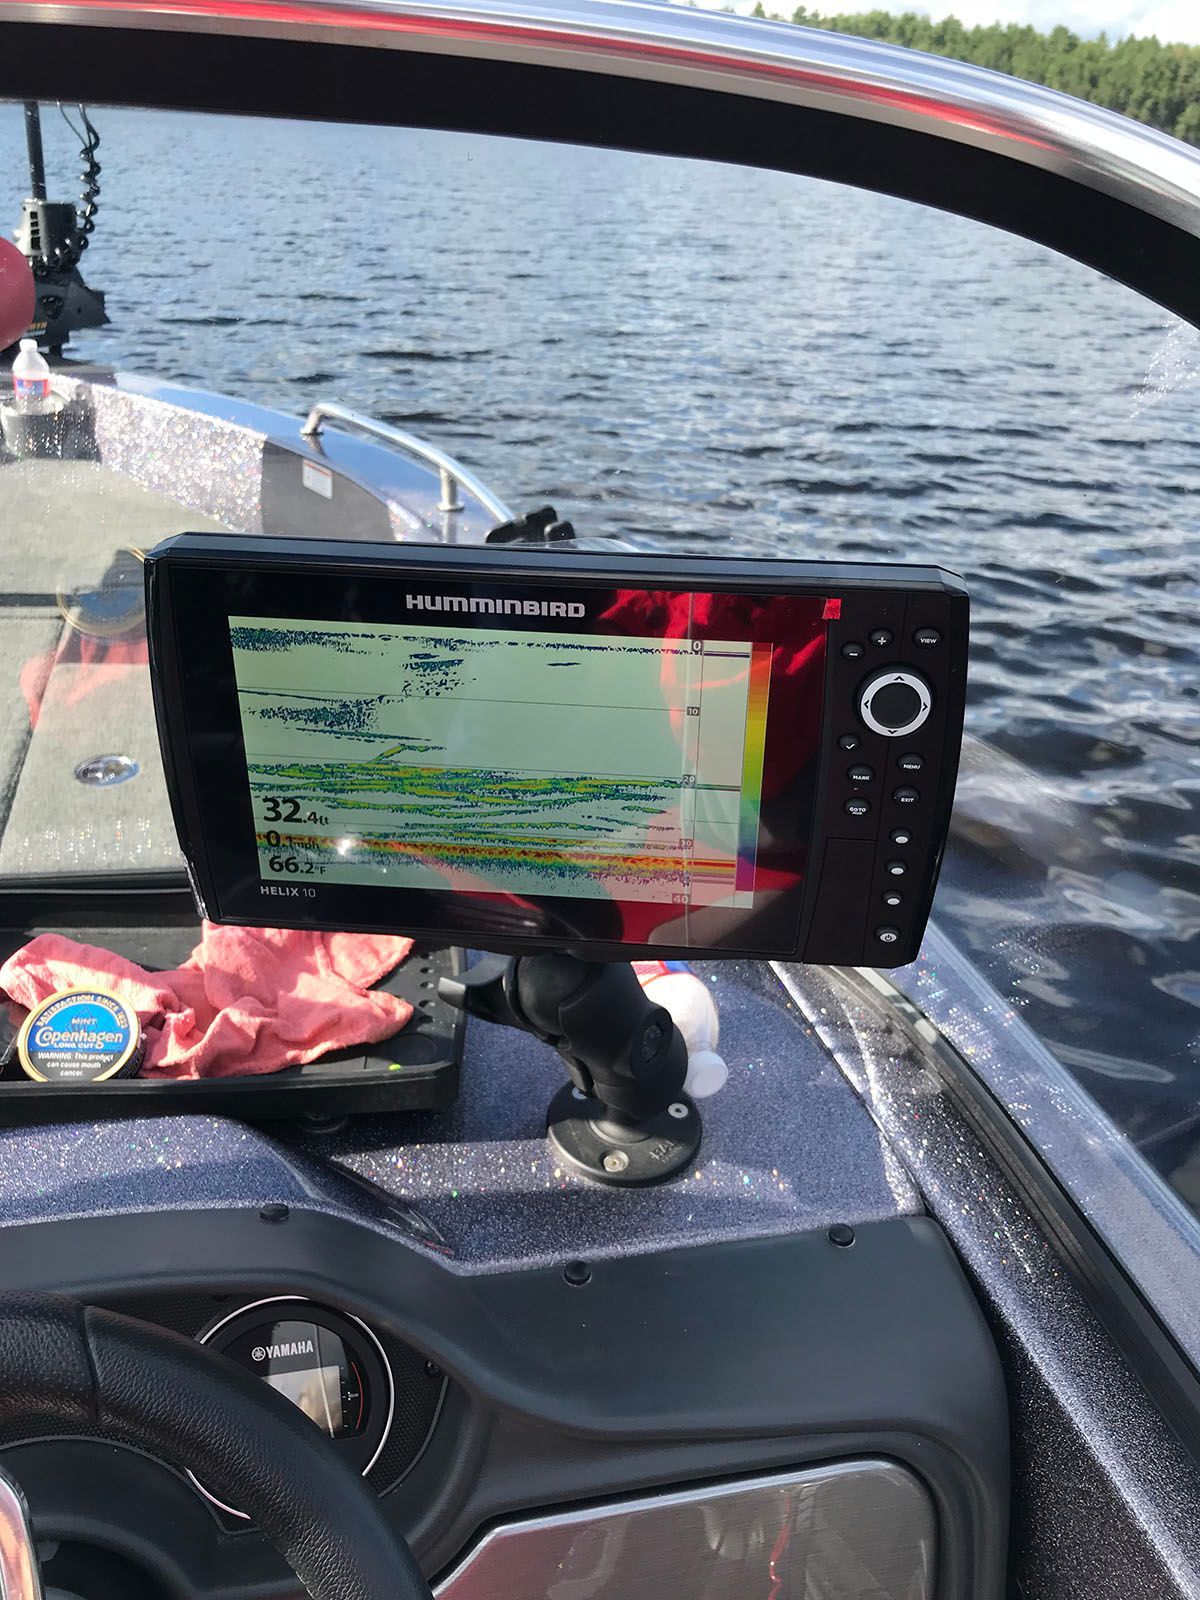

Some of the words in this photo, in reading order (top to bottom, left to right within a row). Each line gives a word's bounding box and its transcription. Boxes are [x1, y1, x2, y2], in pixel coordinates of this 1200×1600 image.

[405, 594, 586, 618] HUMMINBIRD
[688, 707, 699, 716] 10
[260, 886, 300, 897] HELIX
[302, 888, 316, 898] 10
[71, 1017, 98, 1026] MINT
[35, 1026, 124, 1049] Copenhagen
[265, 1340, 314, 1359] YAMAHA
